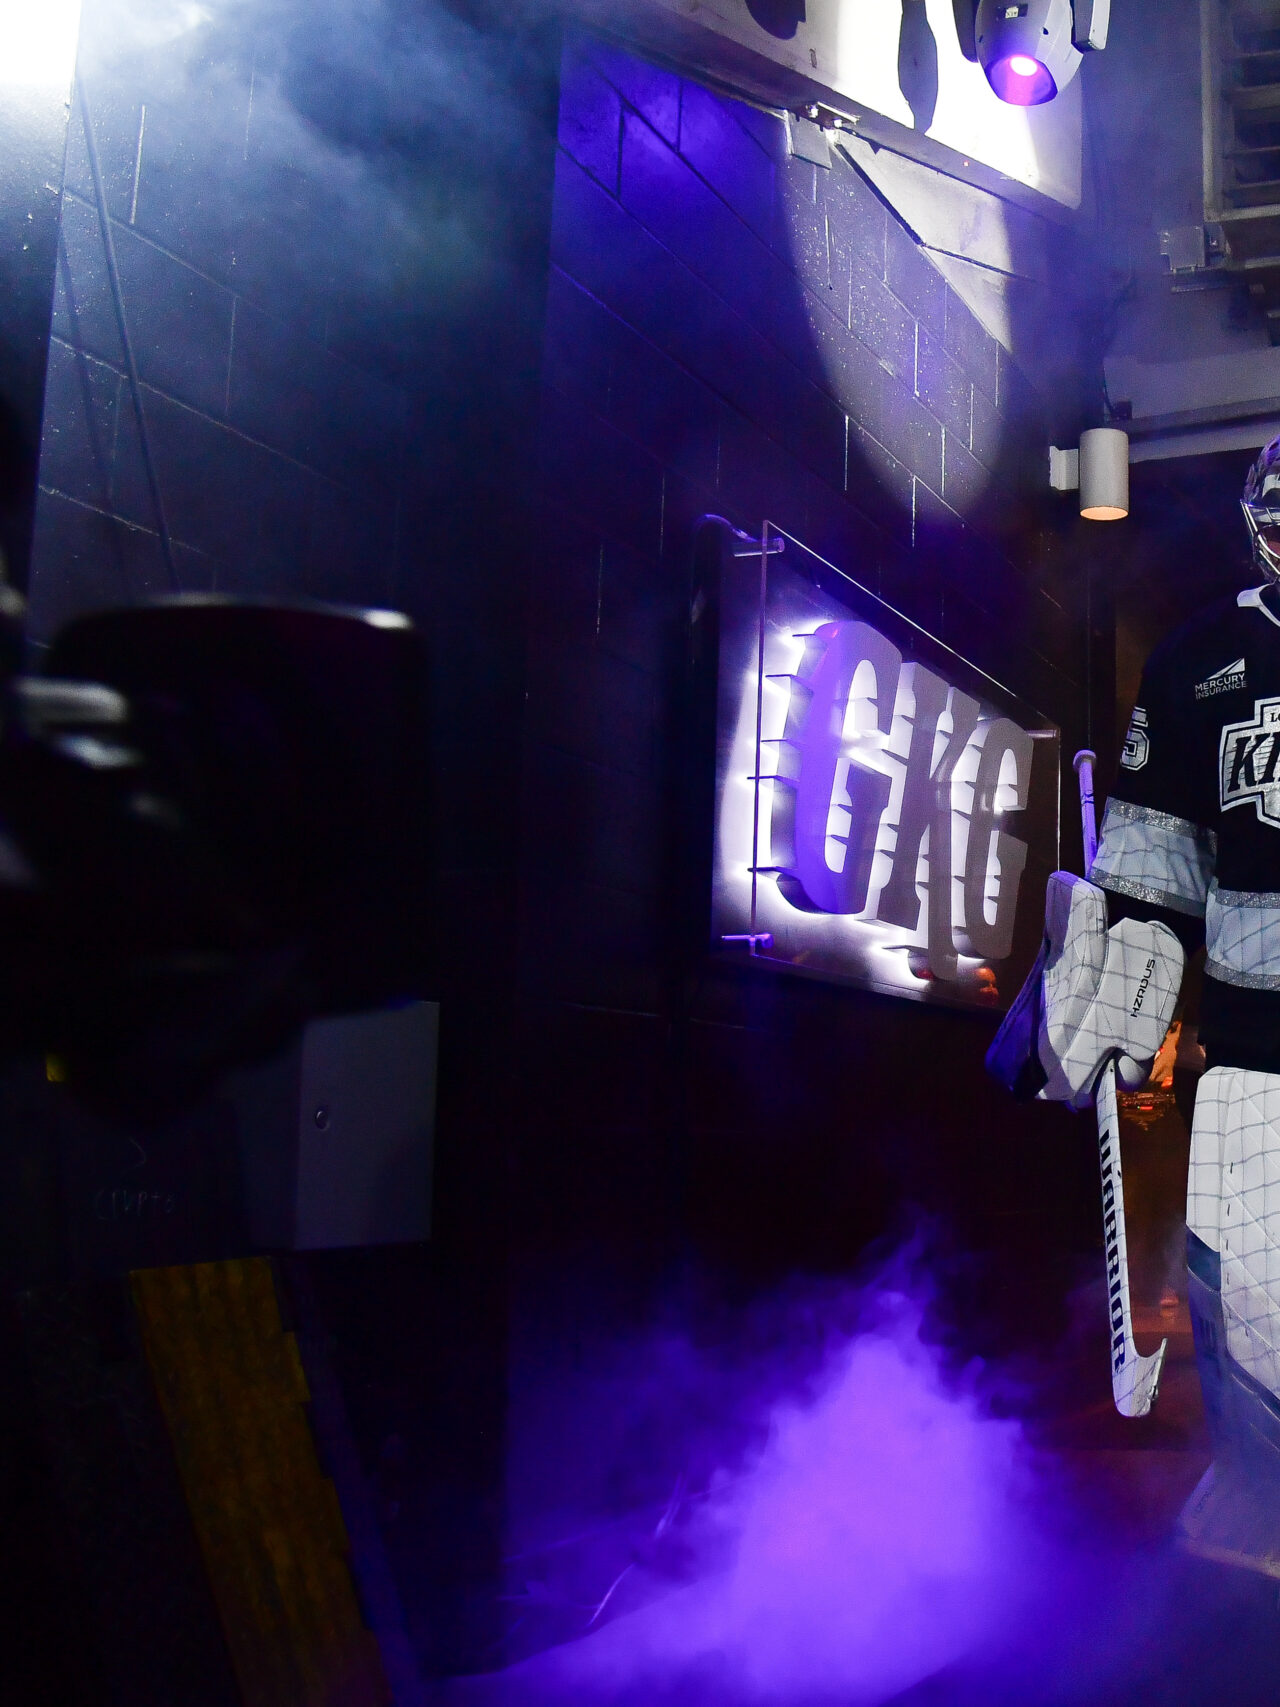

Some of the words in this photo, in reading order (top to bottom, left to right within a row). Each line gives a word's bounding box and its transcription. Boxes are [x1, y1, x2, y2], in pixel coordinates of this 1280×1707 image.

[1194, 672, 1245, 693] MERCURY
[1195, 680, 1248, 700] INSURANCE
[772, 620, 1034, 980] GKG
